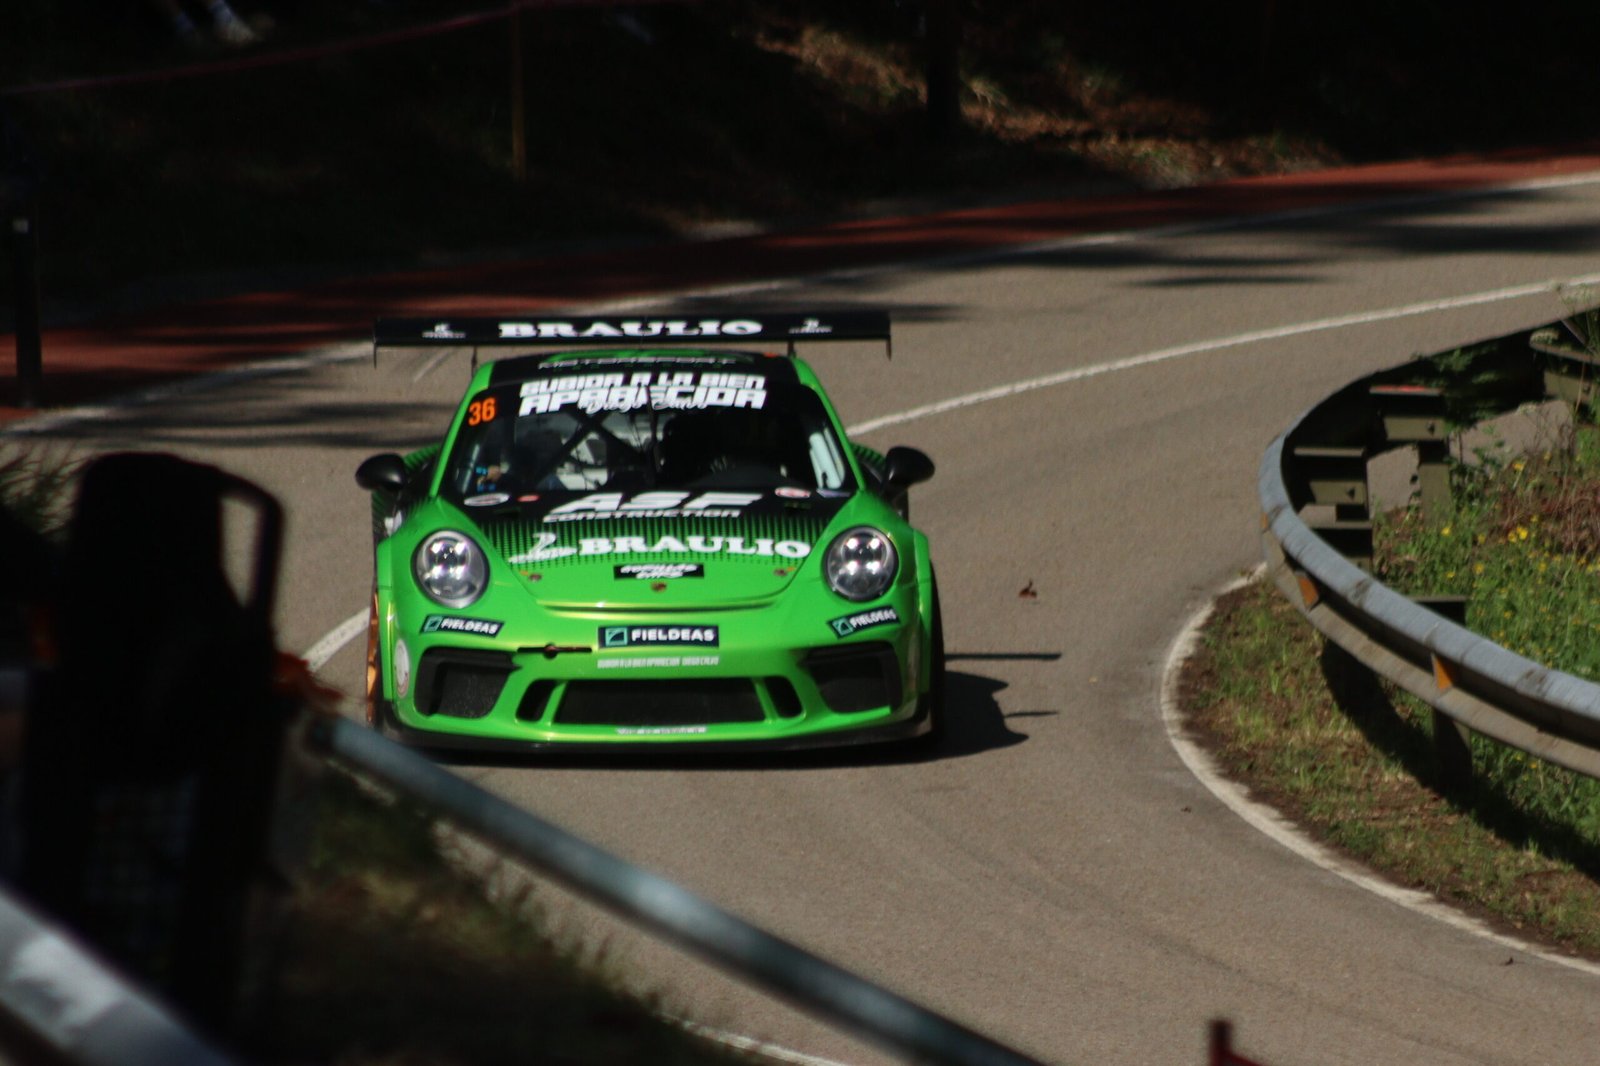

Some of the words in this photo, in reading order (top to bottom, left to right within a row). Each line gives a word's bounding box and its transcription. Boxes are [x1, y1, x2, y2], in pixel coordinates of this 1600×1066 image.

[498, 320, 763, 338] BRAULIO
[519, 371, 624, 398] SUBIDA
[629, 371, 652, 387] A
[657, 371, 694, 387] LA
[699, 371, 766, 390] BIEN
[468, 397, 496, 426] 36
[518, 385, 767, 417] APARECIDA
[551, 491, 763, 514] ASF
[578, 535, 812, 558] BRAULIO
[440, 618, 500, 635] FIELDEAS
[847, 608, 898, 629] FIELDEAS
[630, 627, 716, 643] FIELDEAS
